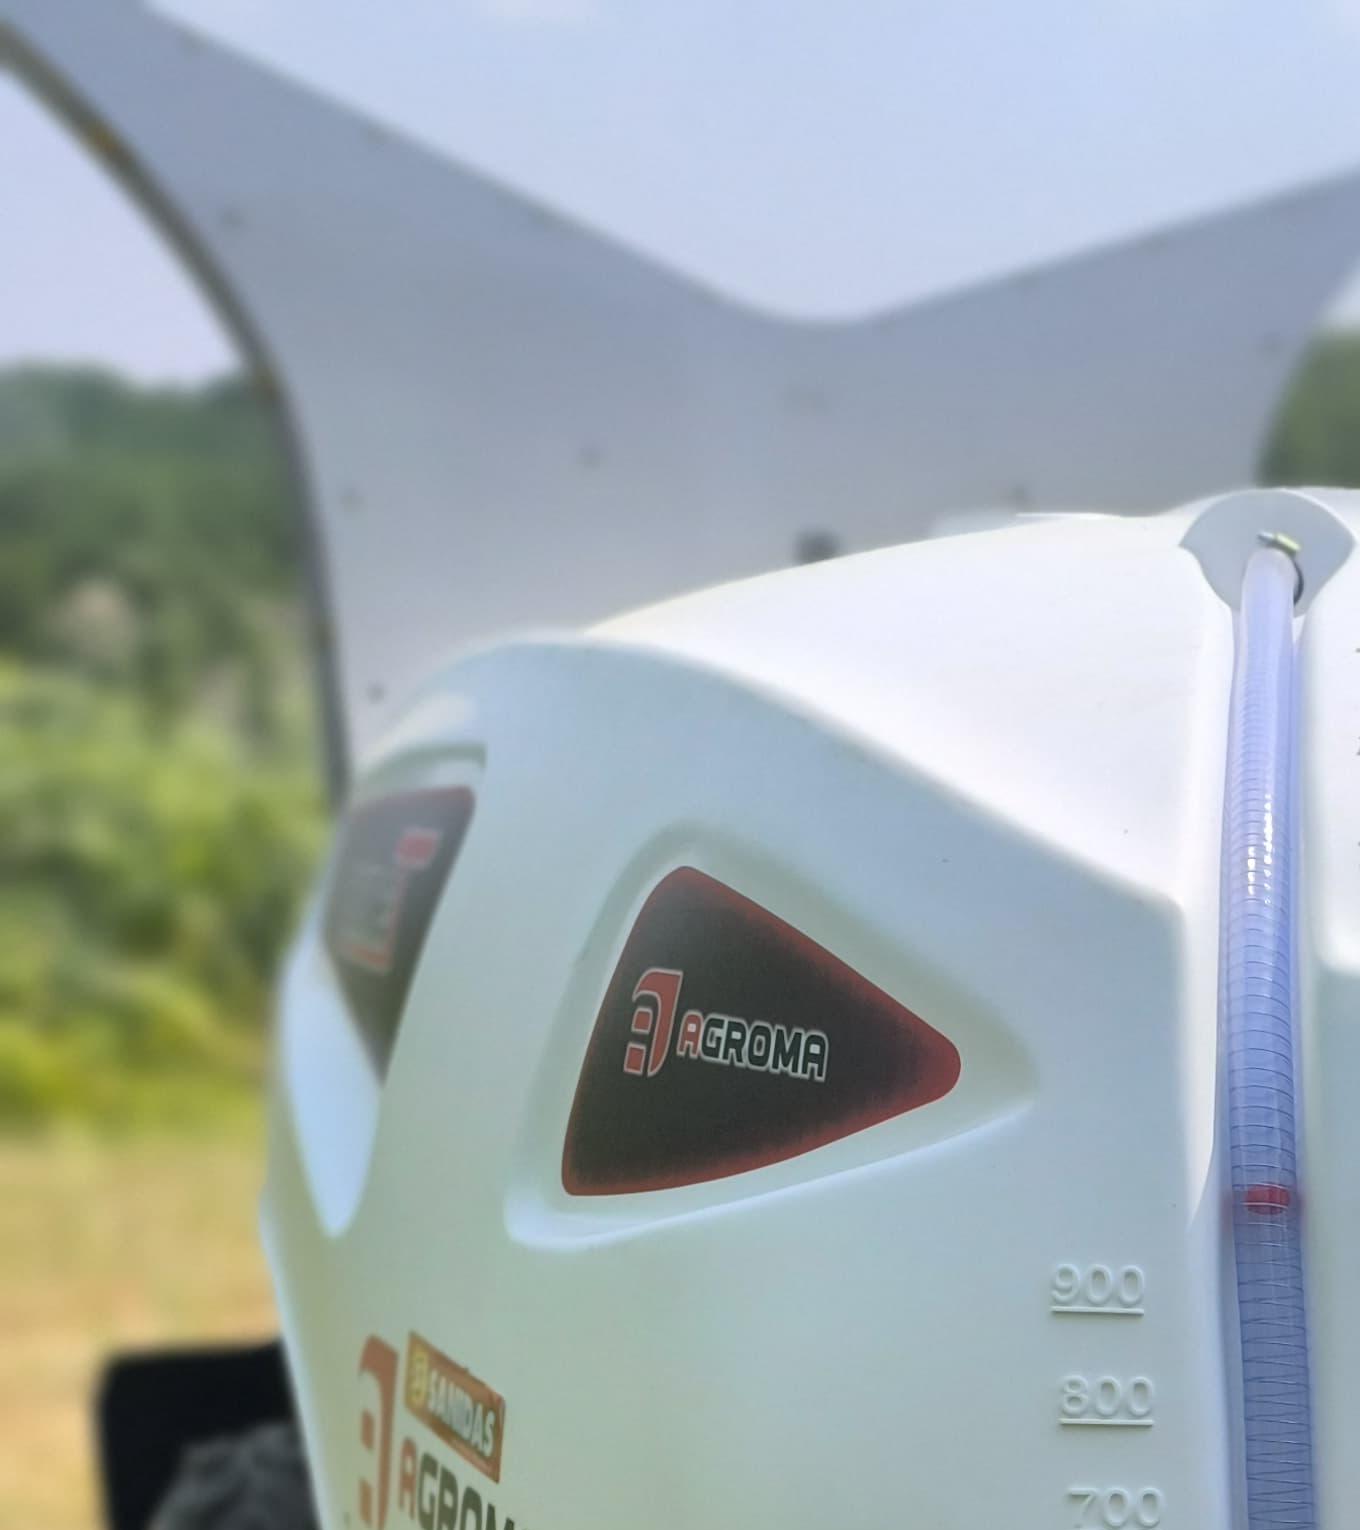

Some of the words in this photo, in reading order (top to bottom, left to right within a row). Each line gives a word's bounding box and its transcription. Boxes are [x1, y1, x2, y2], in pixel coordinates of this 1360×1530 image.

[678, 1010, 829, 1082] AGROMA
[1050, 1263, 1146, 1307] 900
[1058, 1374, 1156, 1418] 800
[1067, 1486, 1163, 1530] 700
